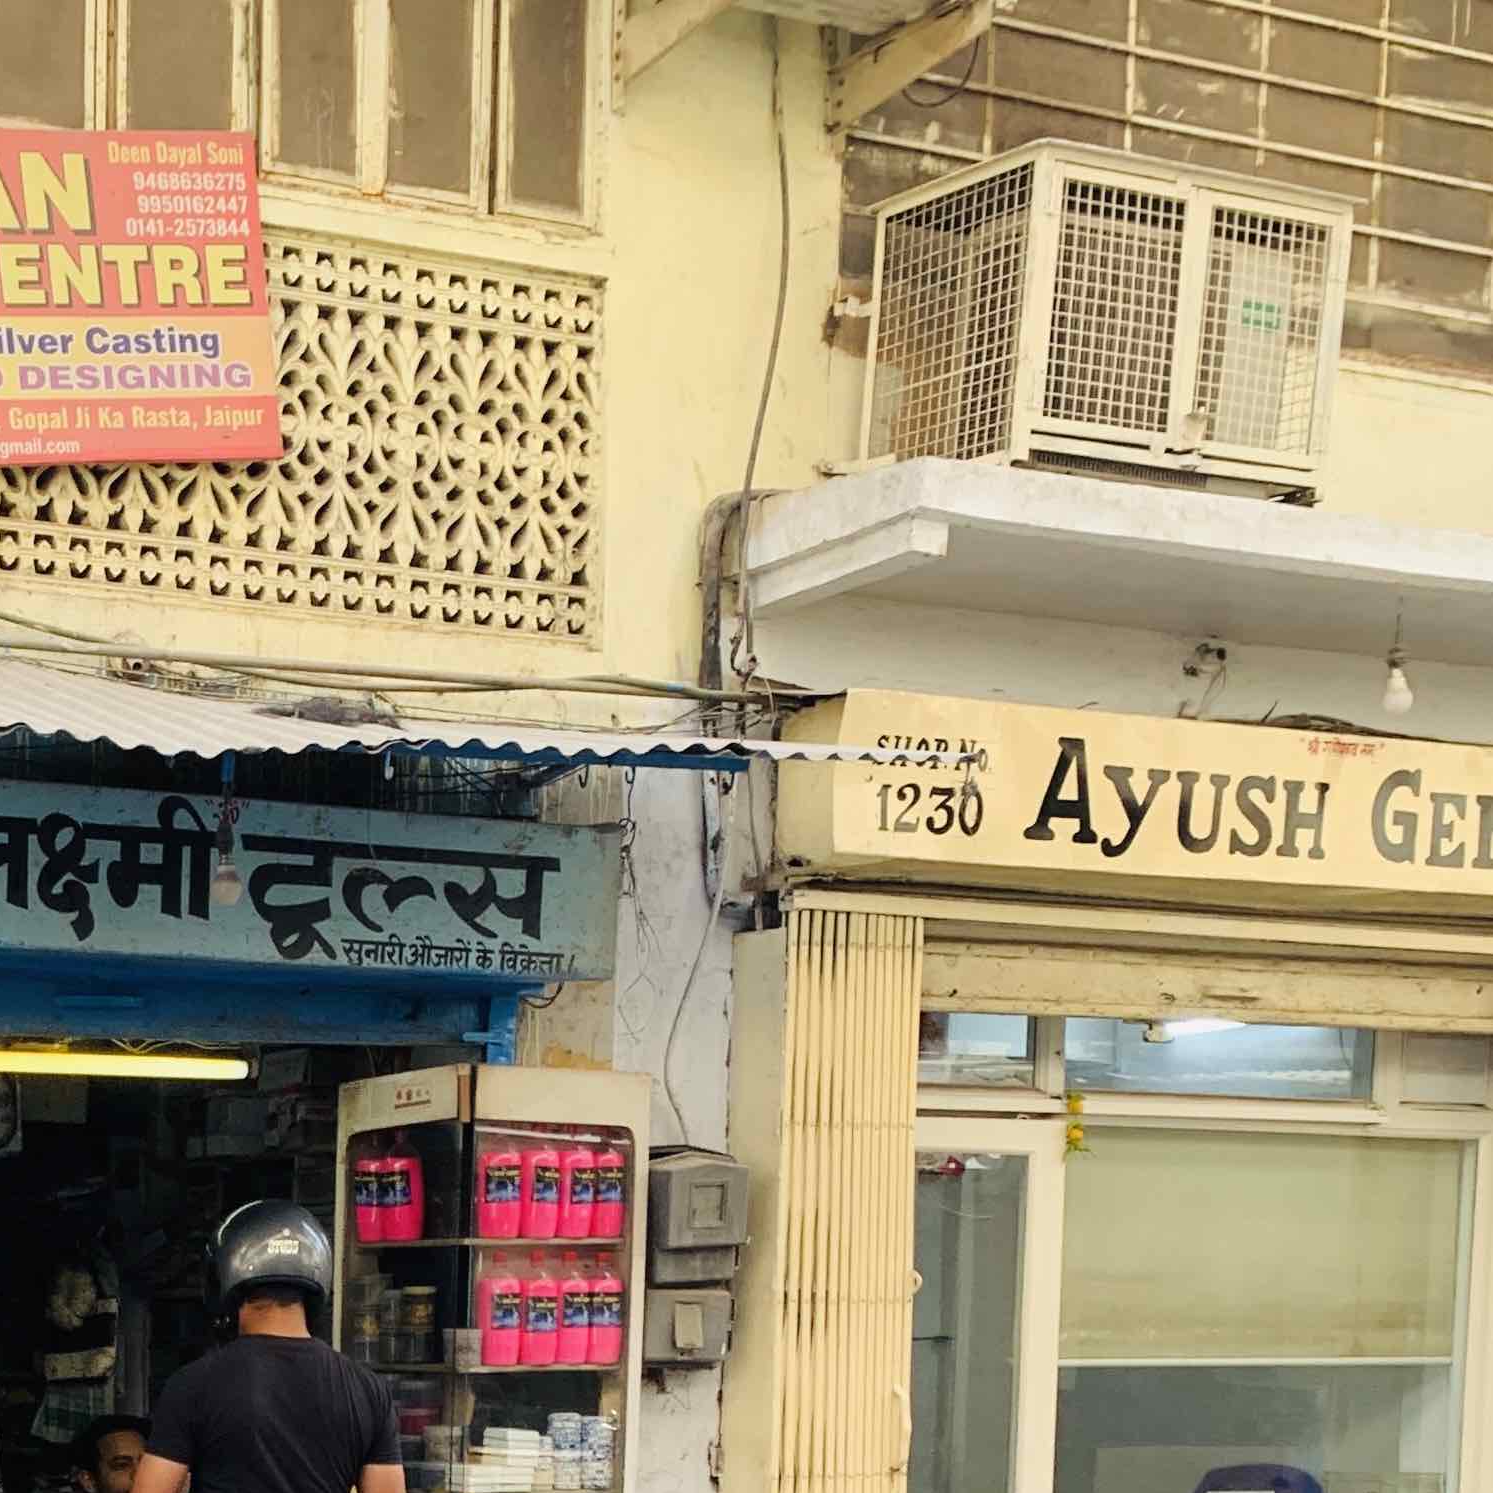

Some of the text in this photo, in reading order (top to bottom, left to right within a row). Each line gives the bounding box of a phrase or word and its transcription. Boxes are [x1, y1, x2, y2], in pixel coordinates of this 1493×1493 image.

[107, 141, 244, 168] Deen Dayal Soni
[85, 326, 220, 359] Casting
[18, 363, 252, 390] DESIGNING
[8, 406, 68, 434] Gopal
[75, 406, 91, 430] Ji
[98, 406, 124, 430] Ka
[204, 404, 264, 431] Jaipur
[876, 782, 984, 837] 1230
[240, 833, 562, 961] टूल्स
[475, 940, 495, 969] के
